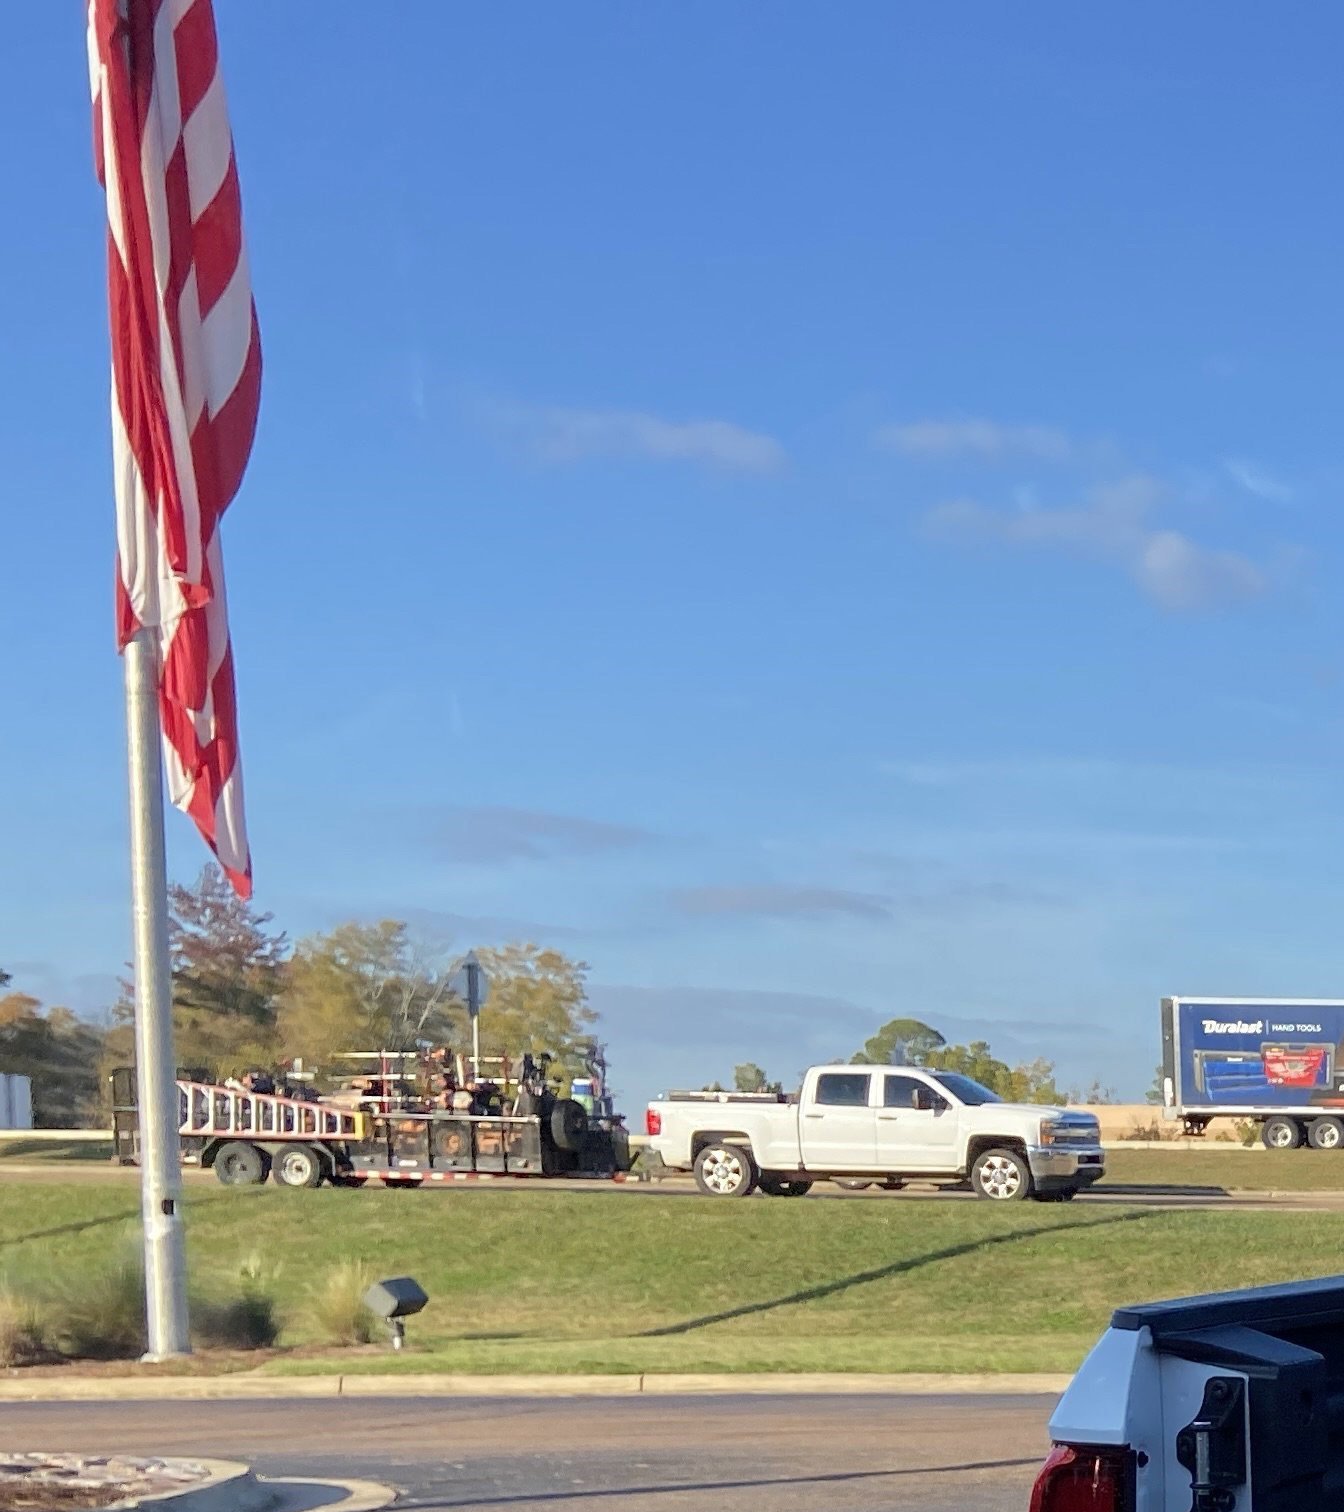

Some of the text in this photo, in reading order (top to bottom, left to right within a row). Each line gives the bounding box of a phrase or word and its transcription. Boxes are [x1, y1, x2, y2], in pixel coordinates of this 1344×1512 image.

[1202, 1020, 1322, 1034] Duralast HAND TOOLS
